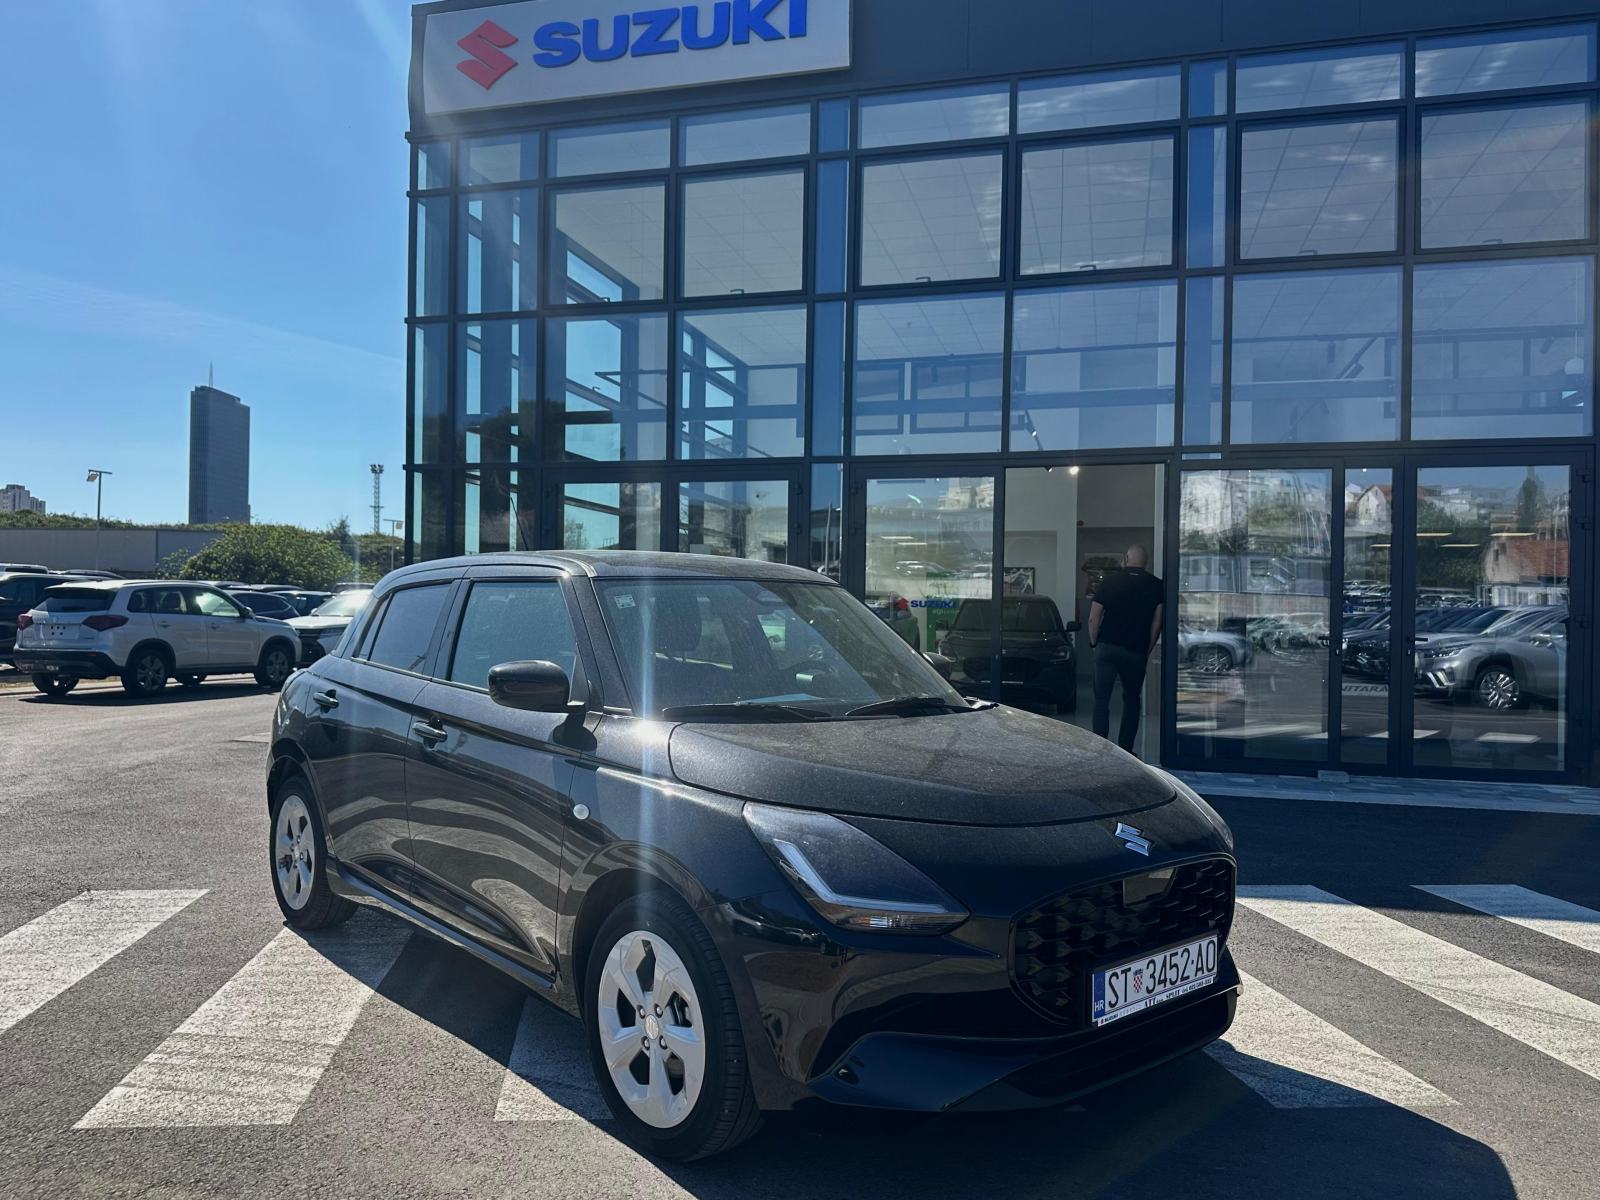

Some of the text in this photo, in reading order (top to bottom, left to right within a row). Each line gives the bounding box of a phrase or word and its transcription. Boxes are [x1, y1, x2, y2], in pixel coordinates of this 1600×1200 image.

[533, 0, 807, 68] SUZUKI
[910, 599, 956, 609] SUZUKI
[1108, 967, 1132, 1009] ST
[1094, 999, 1105, 1013] HR
